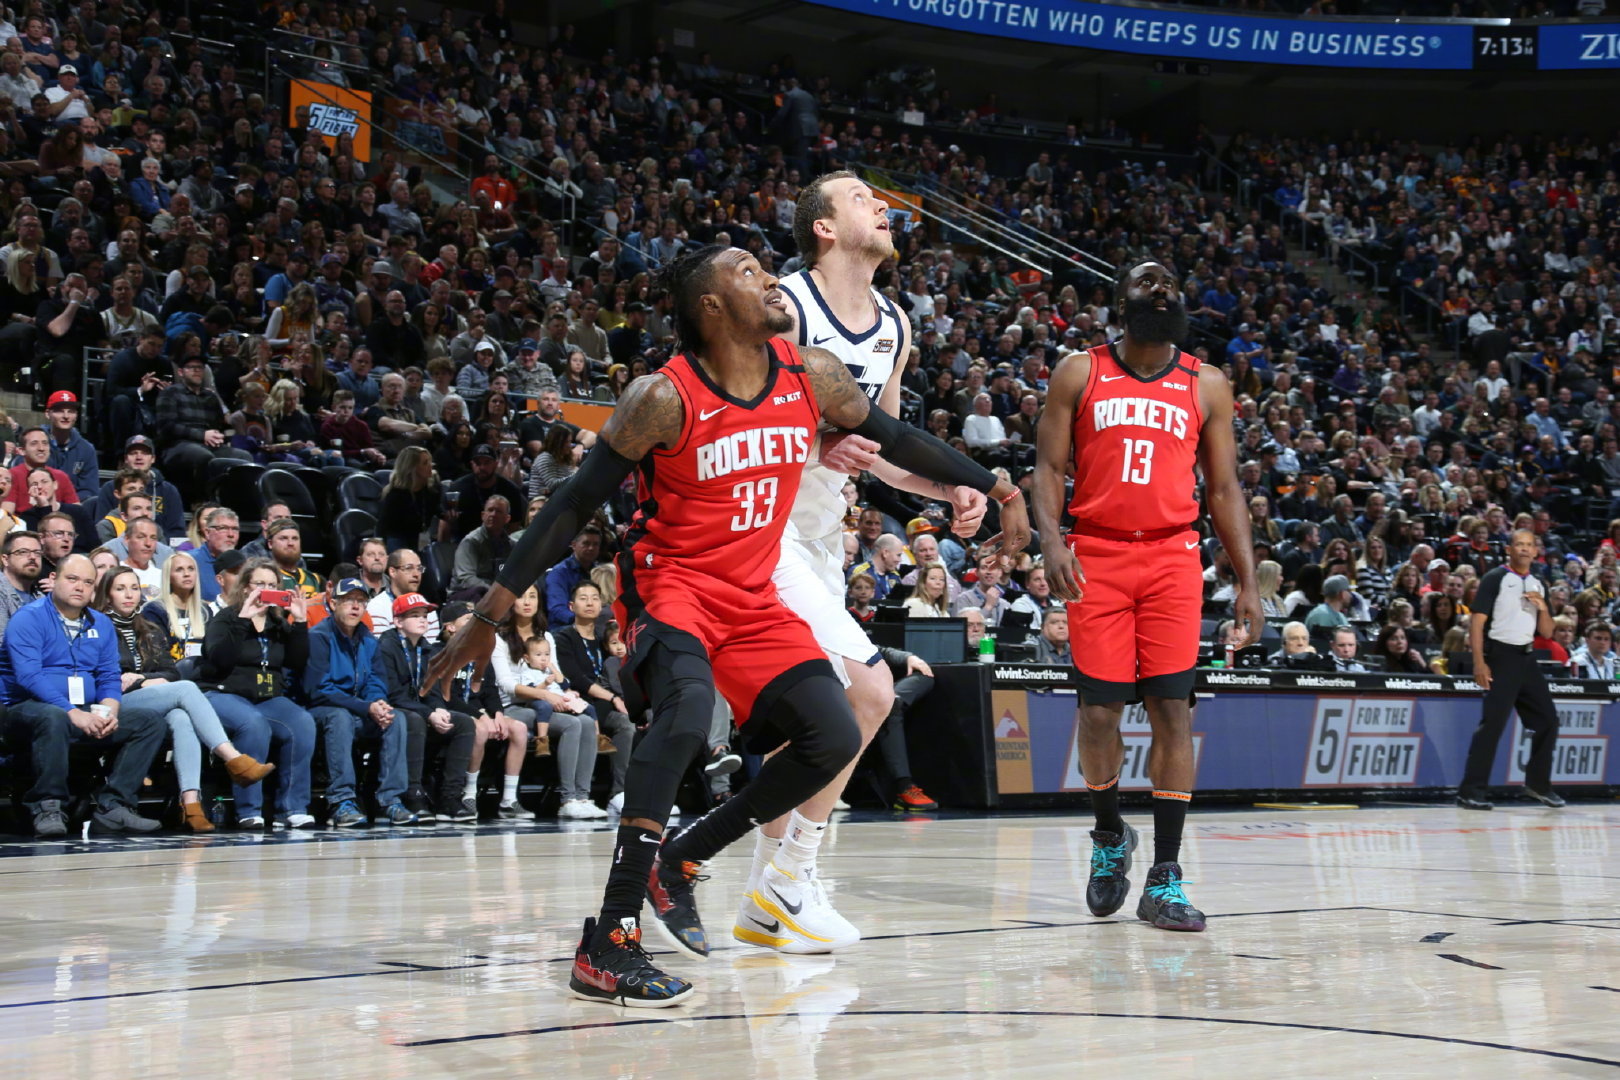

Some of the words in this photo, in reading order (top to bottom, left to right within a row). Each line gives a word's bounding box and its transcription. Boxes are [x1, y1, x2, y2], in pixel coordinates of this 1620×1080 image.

[1049, 9, 1104, 36] WHO
[1113, 17, 1198, 45] KEEPS
[1207, 26, 1241, 48] US
[1251, 29, 1280, 51] IN
[1479, 37, 1523, 55] 7:13
[308, 107, 322, 128] 5
[322, 121, 355, 134] FIGHT
[1094, 397, 1189, 440] ROCKETS
[697, 427, 808, 481] ROCKETS
[1121, 438, 1155, 485] 13
[731, 477, 779, 531] 33
[1127, 705, 1149, 724] FO
[1356, 707, 1381, 726] FOR
[1385, 707, 1409, 726] THE
[1556, 710, 1572, 728] OR
[1576, 711, 1596, 729] THE
[1315, 708, 1343, 774] 5
[1347, 744, 1415, 776] FIGHT
[1553, 745, 1603, 775] IGHT
